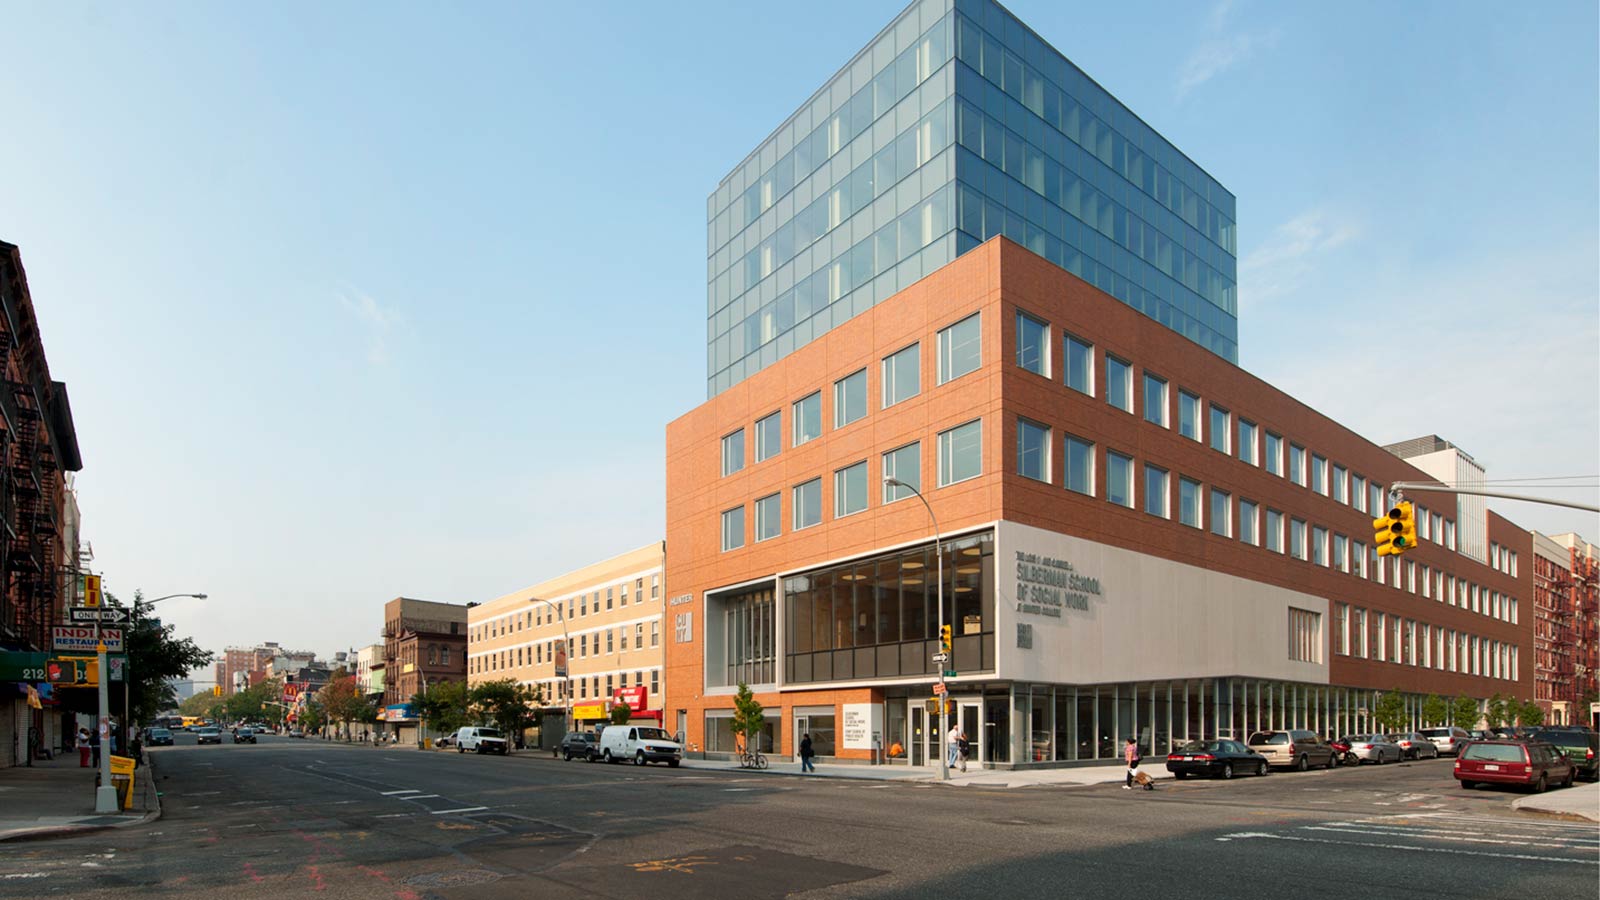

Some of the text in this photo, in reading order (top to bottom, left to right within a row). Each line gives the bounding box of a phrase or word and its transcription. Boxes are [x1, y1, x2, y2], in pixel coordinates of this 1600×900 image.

[1016, 562, 1066, 588] SILBERMAN
[1069, 574, 1100, 595] SCHOOL
[1016, 582, 1089, 611] OF SOCIAL WORK
[78, 611, 121, 619] ONE WAY
